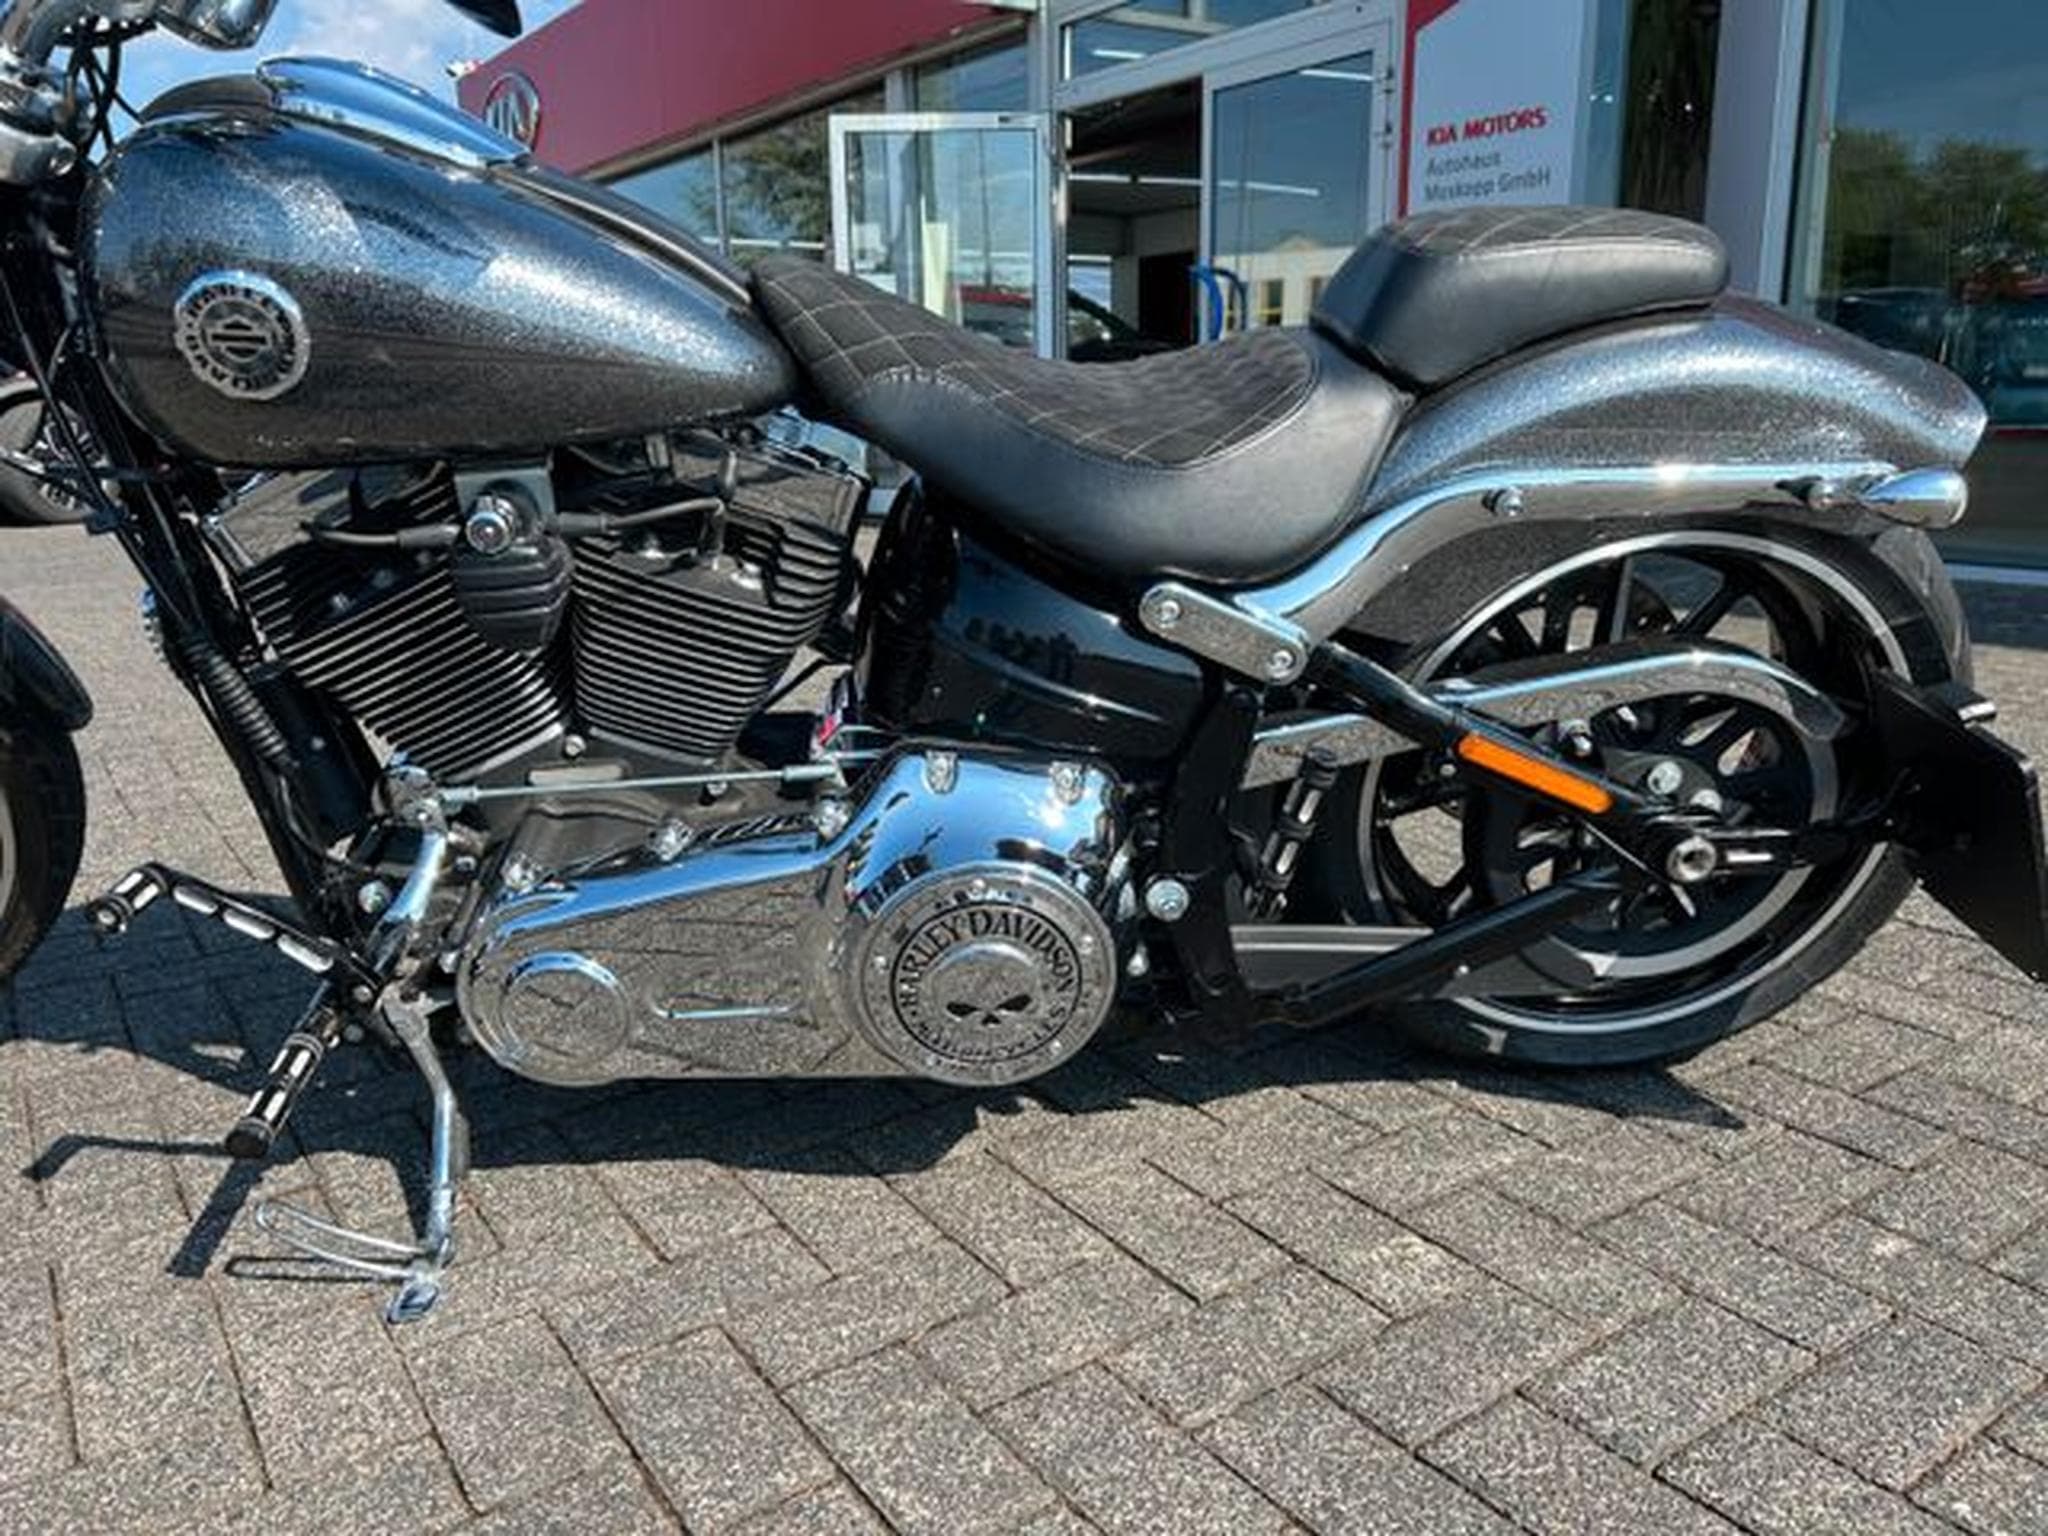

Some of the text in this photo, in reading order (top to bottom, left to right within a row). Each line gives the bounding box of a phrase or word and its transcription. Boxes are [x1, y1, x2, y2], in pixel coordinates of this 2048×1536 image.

[1427, 107, 1546, 145] KIA MOTORS
[1498, 166, 1550, 193] GmbH
